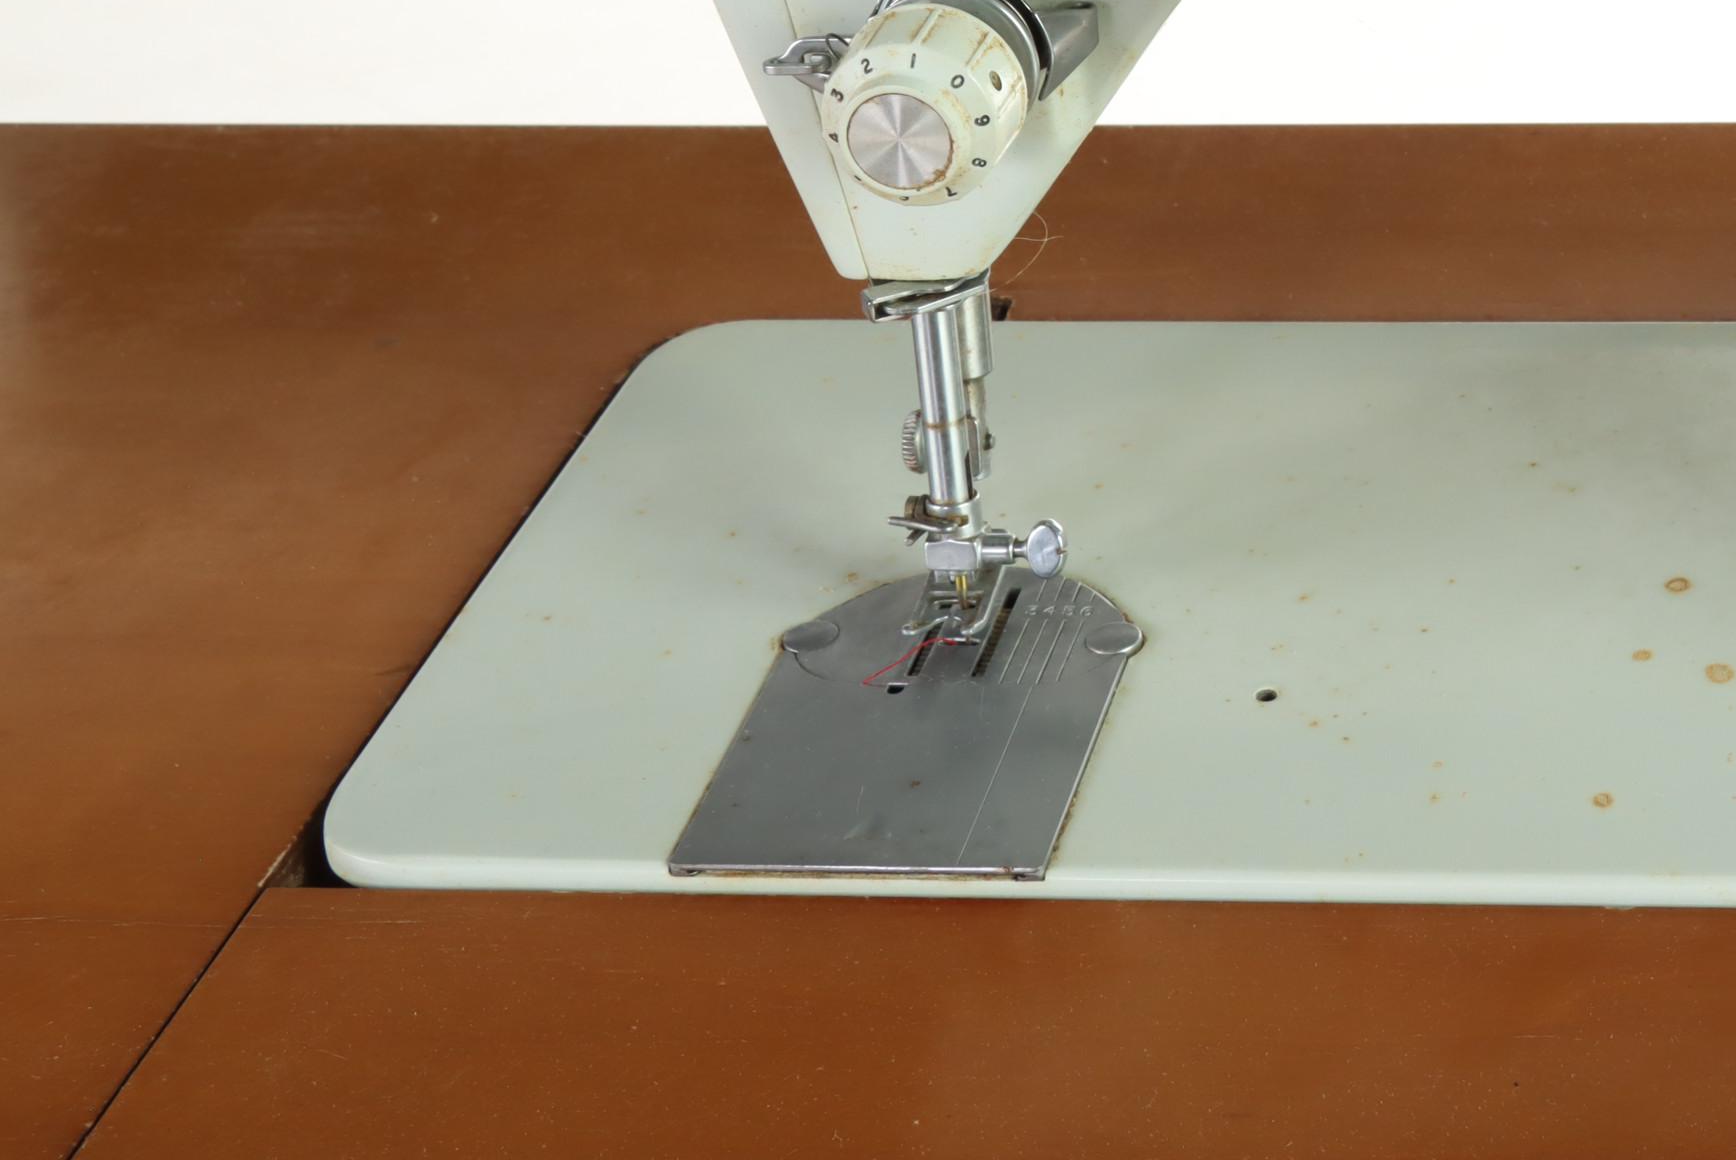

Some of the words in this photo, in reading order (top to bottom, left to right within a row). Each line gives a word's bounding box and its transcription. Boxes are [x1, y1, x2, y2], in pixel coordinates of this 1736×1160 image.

[860, 57, 874, 74] 2
[830, 88, 845, 103] 3
[828, 131, 840, 144] 4
[971, 157, 988, 168] 8
